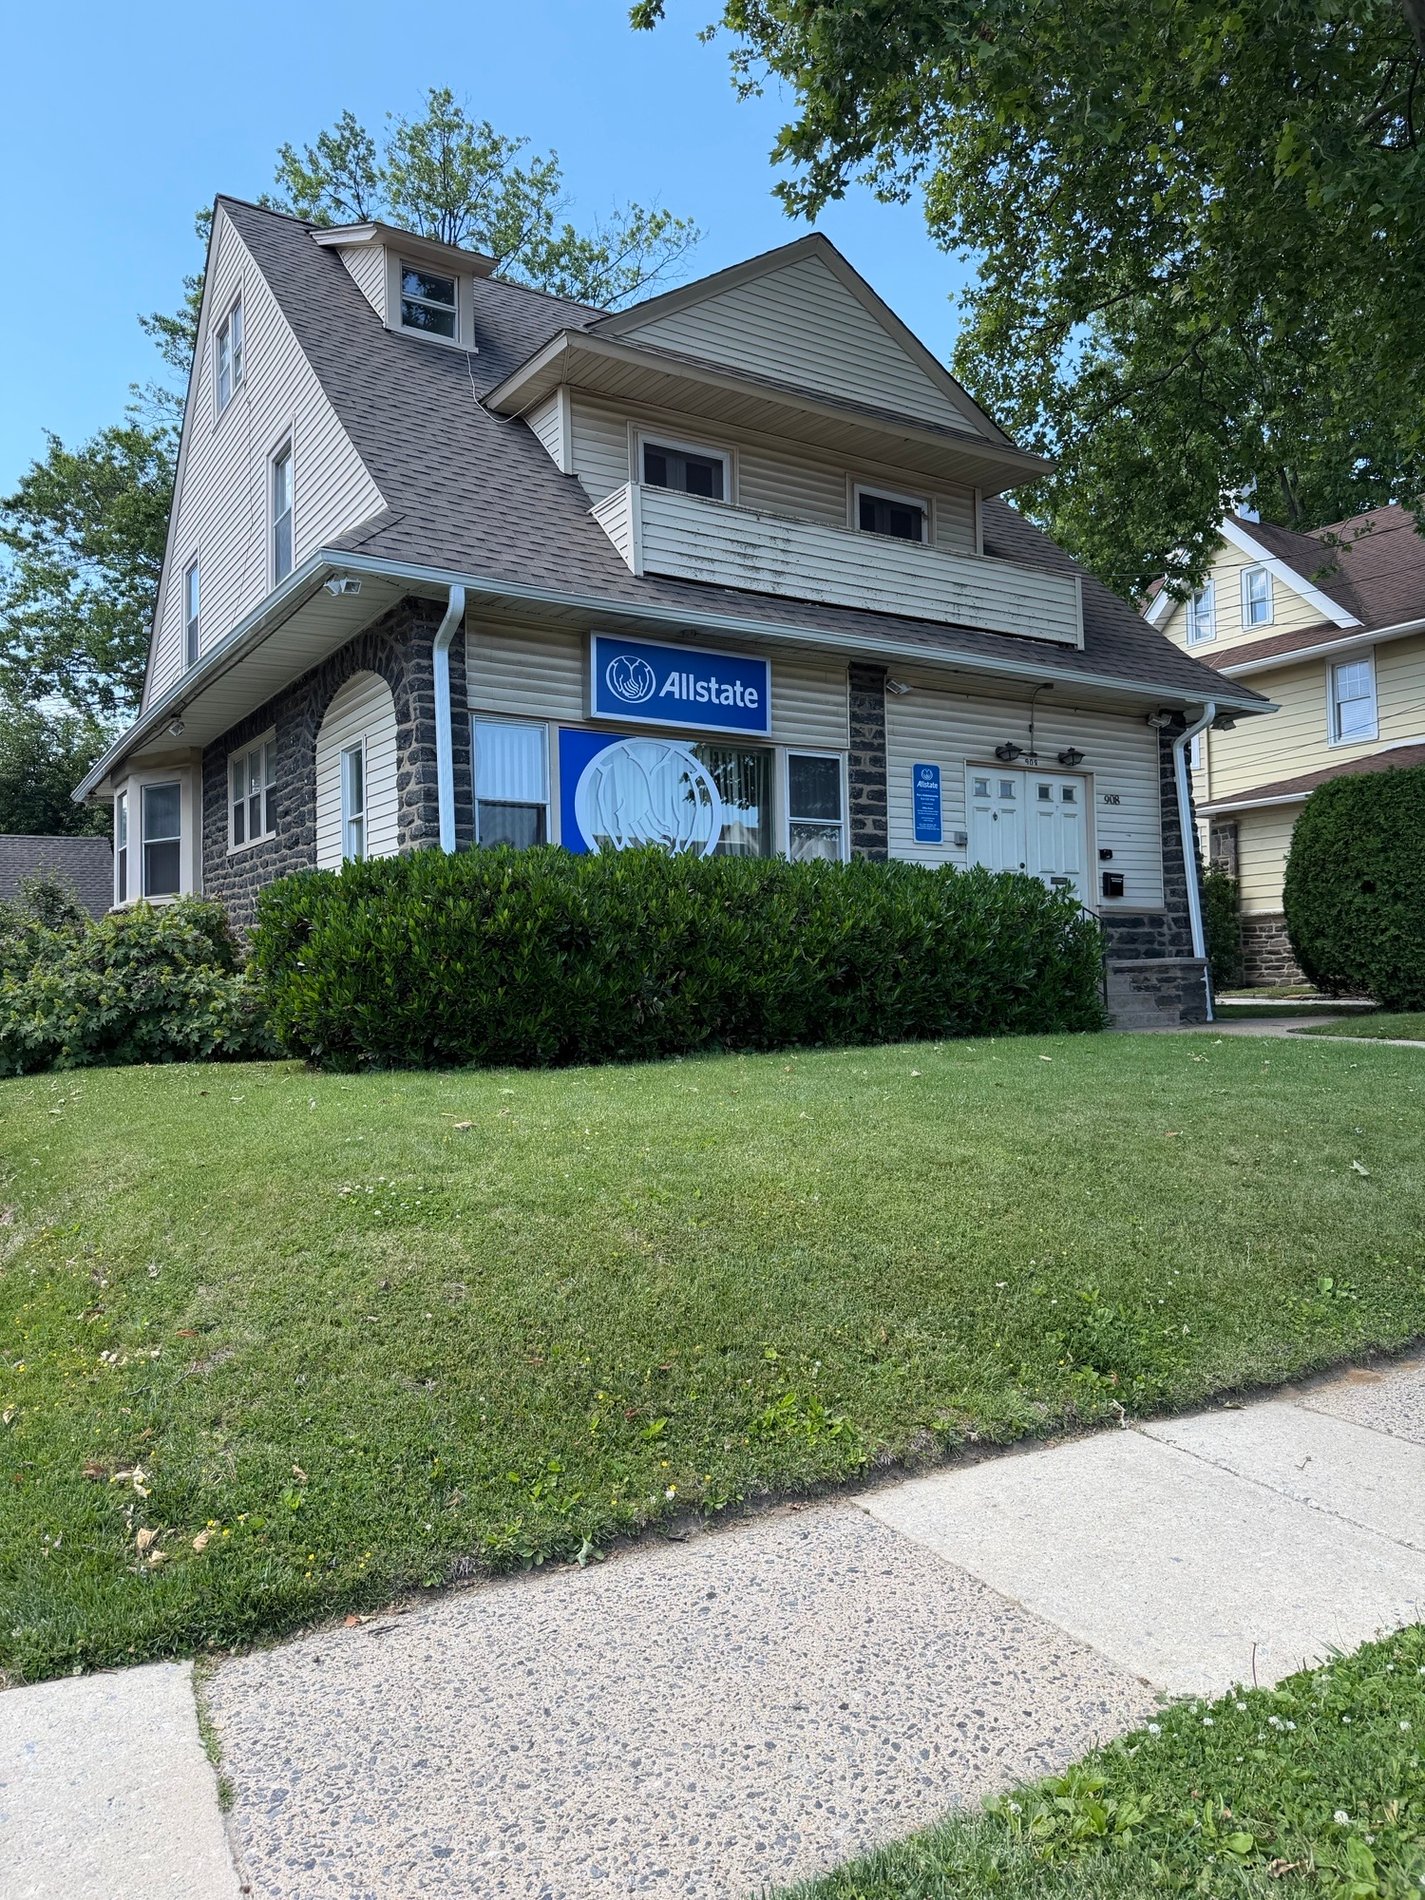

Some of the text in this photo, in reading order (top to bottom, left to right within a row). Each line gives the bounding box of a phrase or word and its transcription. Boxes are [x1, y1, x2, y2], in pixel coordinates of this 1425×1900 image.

[659, 671, 759, 709] Allstate
[916, 780, 938, 789] Allstate
[1103, 794, 1121, 805] 908
